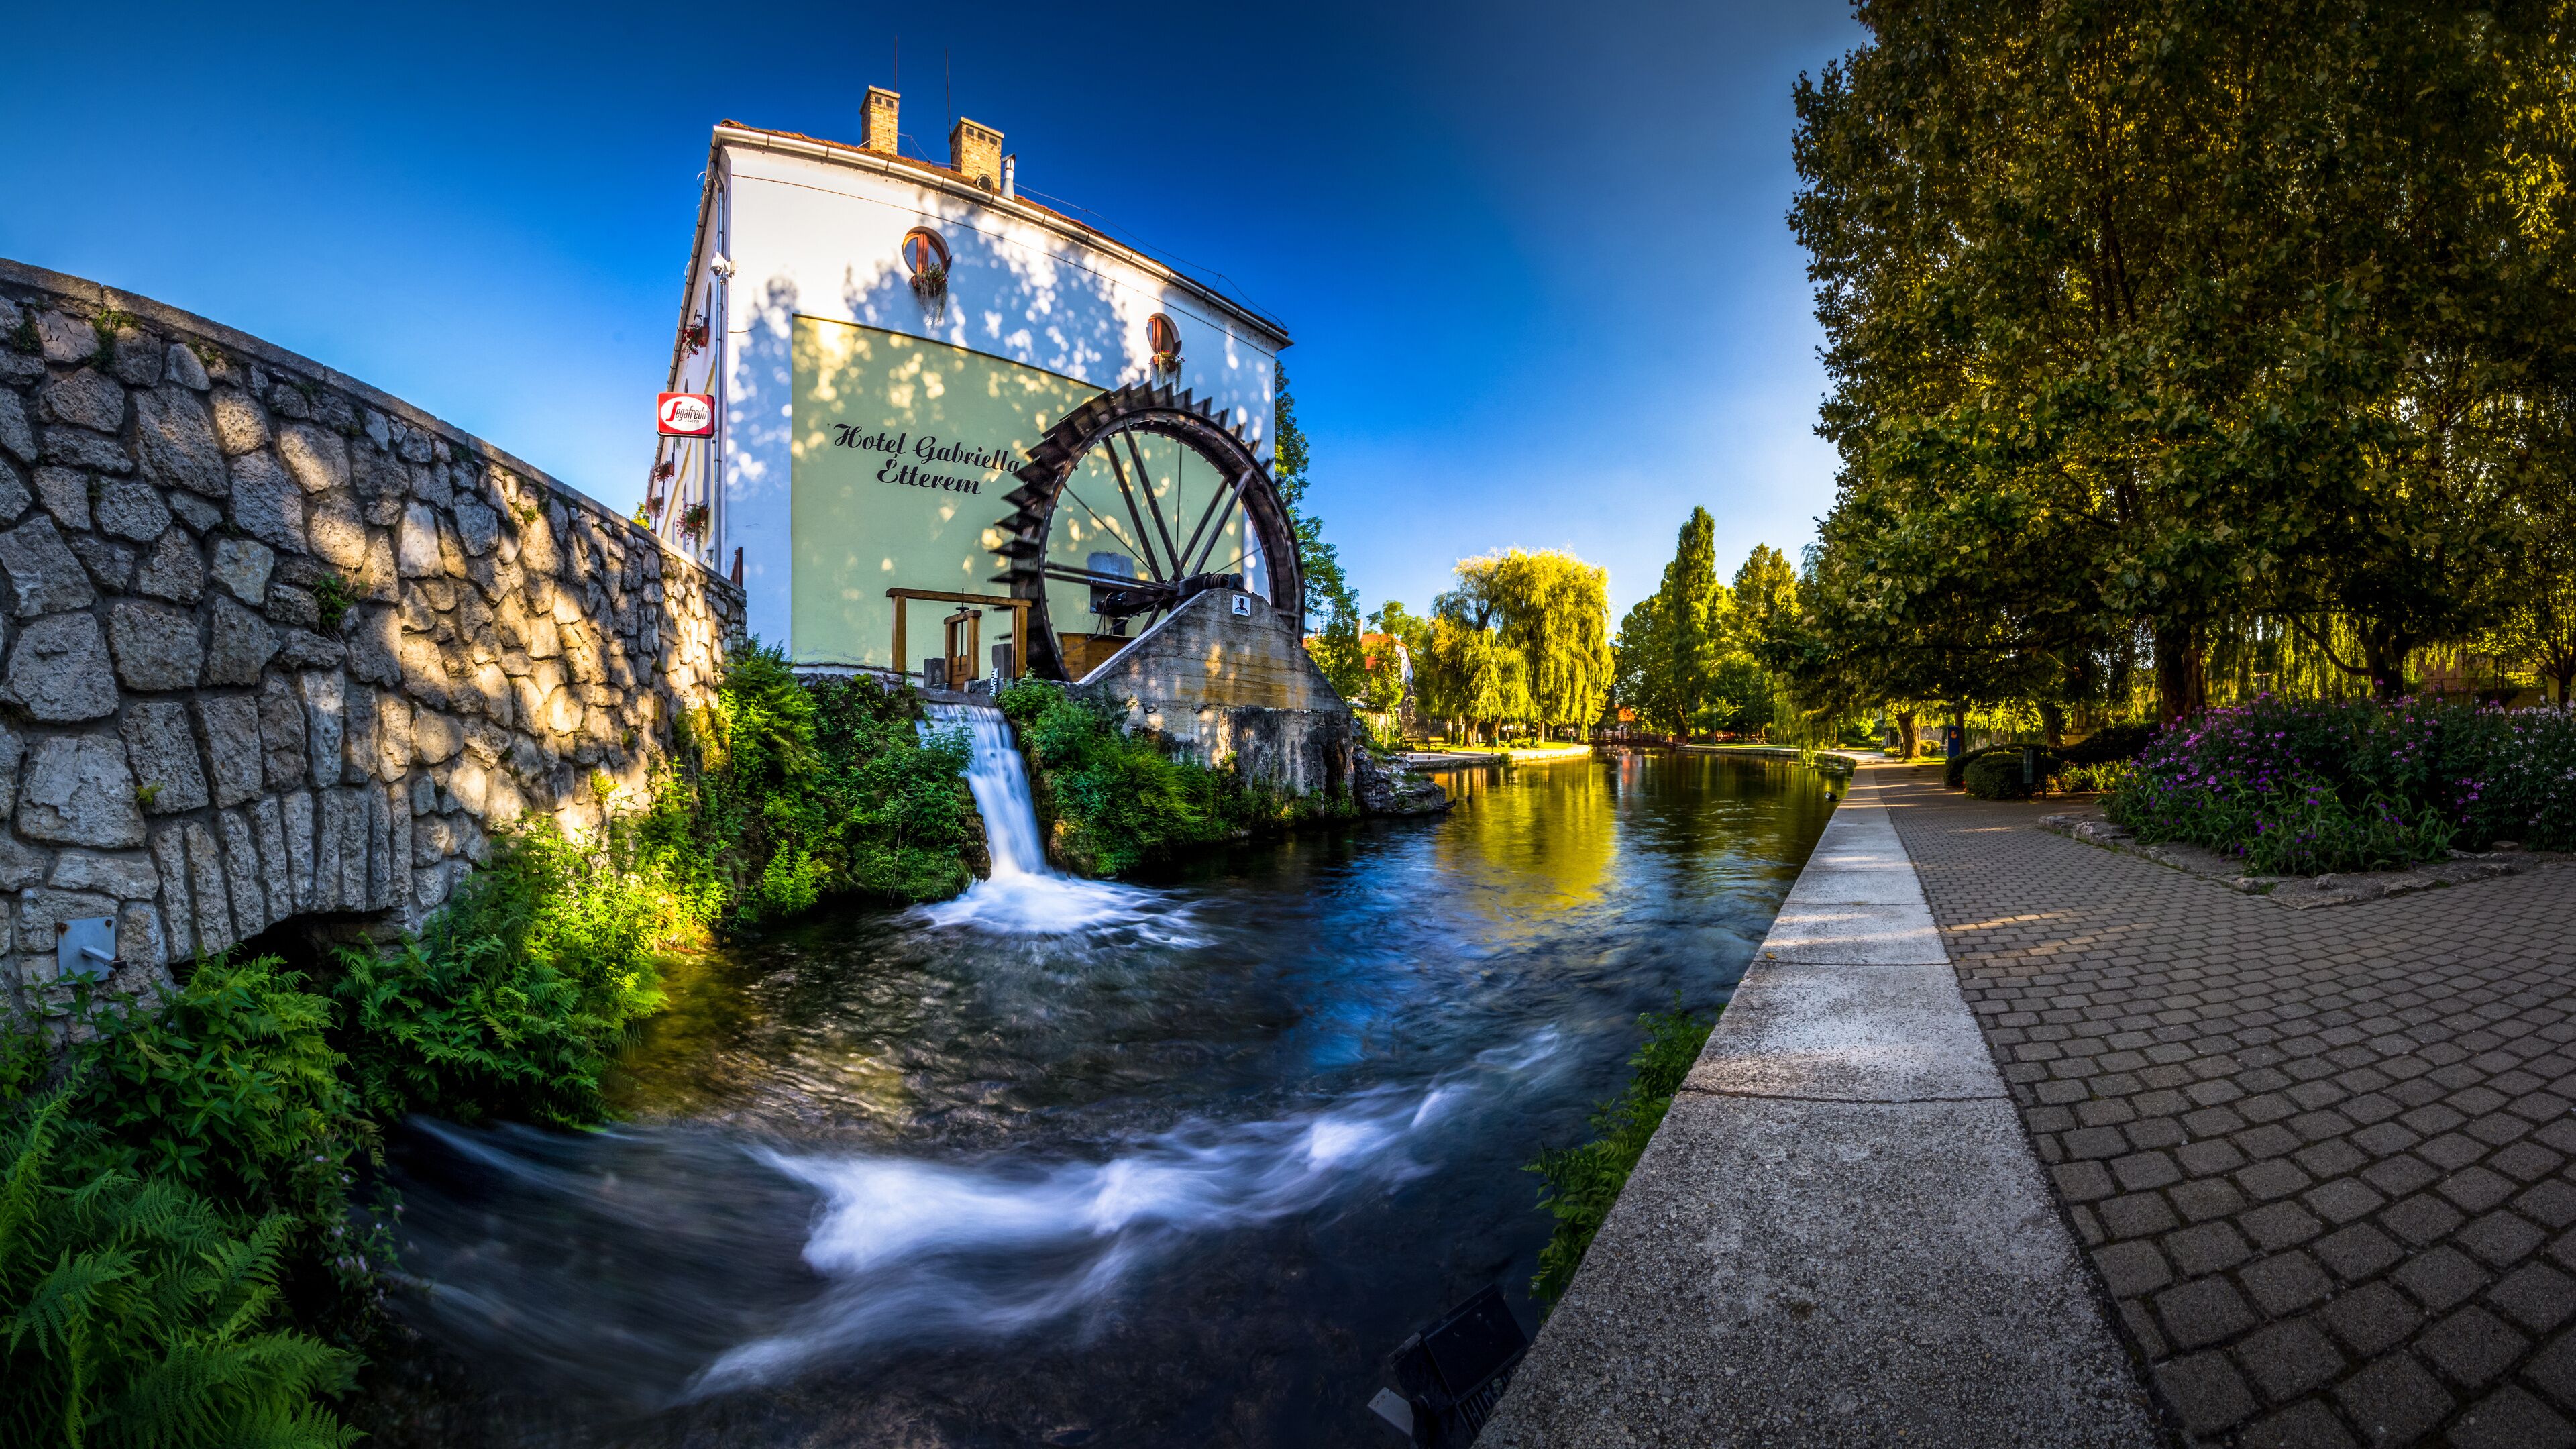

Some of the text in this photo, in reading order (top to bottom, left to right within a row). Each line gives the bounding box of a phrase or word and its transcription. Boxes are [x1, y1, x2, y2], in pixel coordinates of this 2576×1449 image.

[665, 401, 708, 421] Segafredo
[833, 423, 1020, 472] Hotel Gabriella
[877, 453, 981, 494] Étterem
